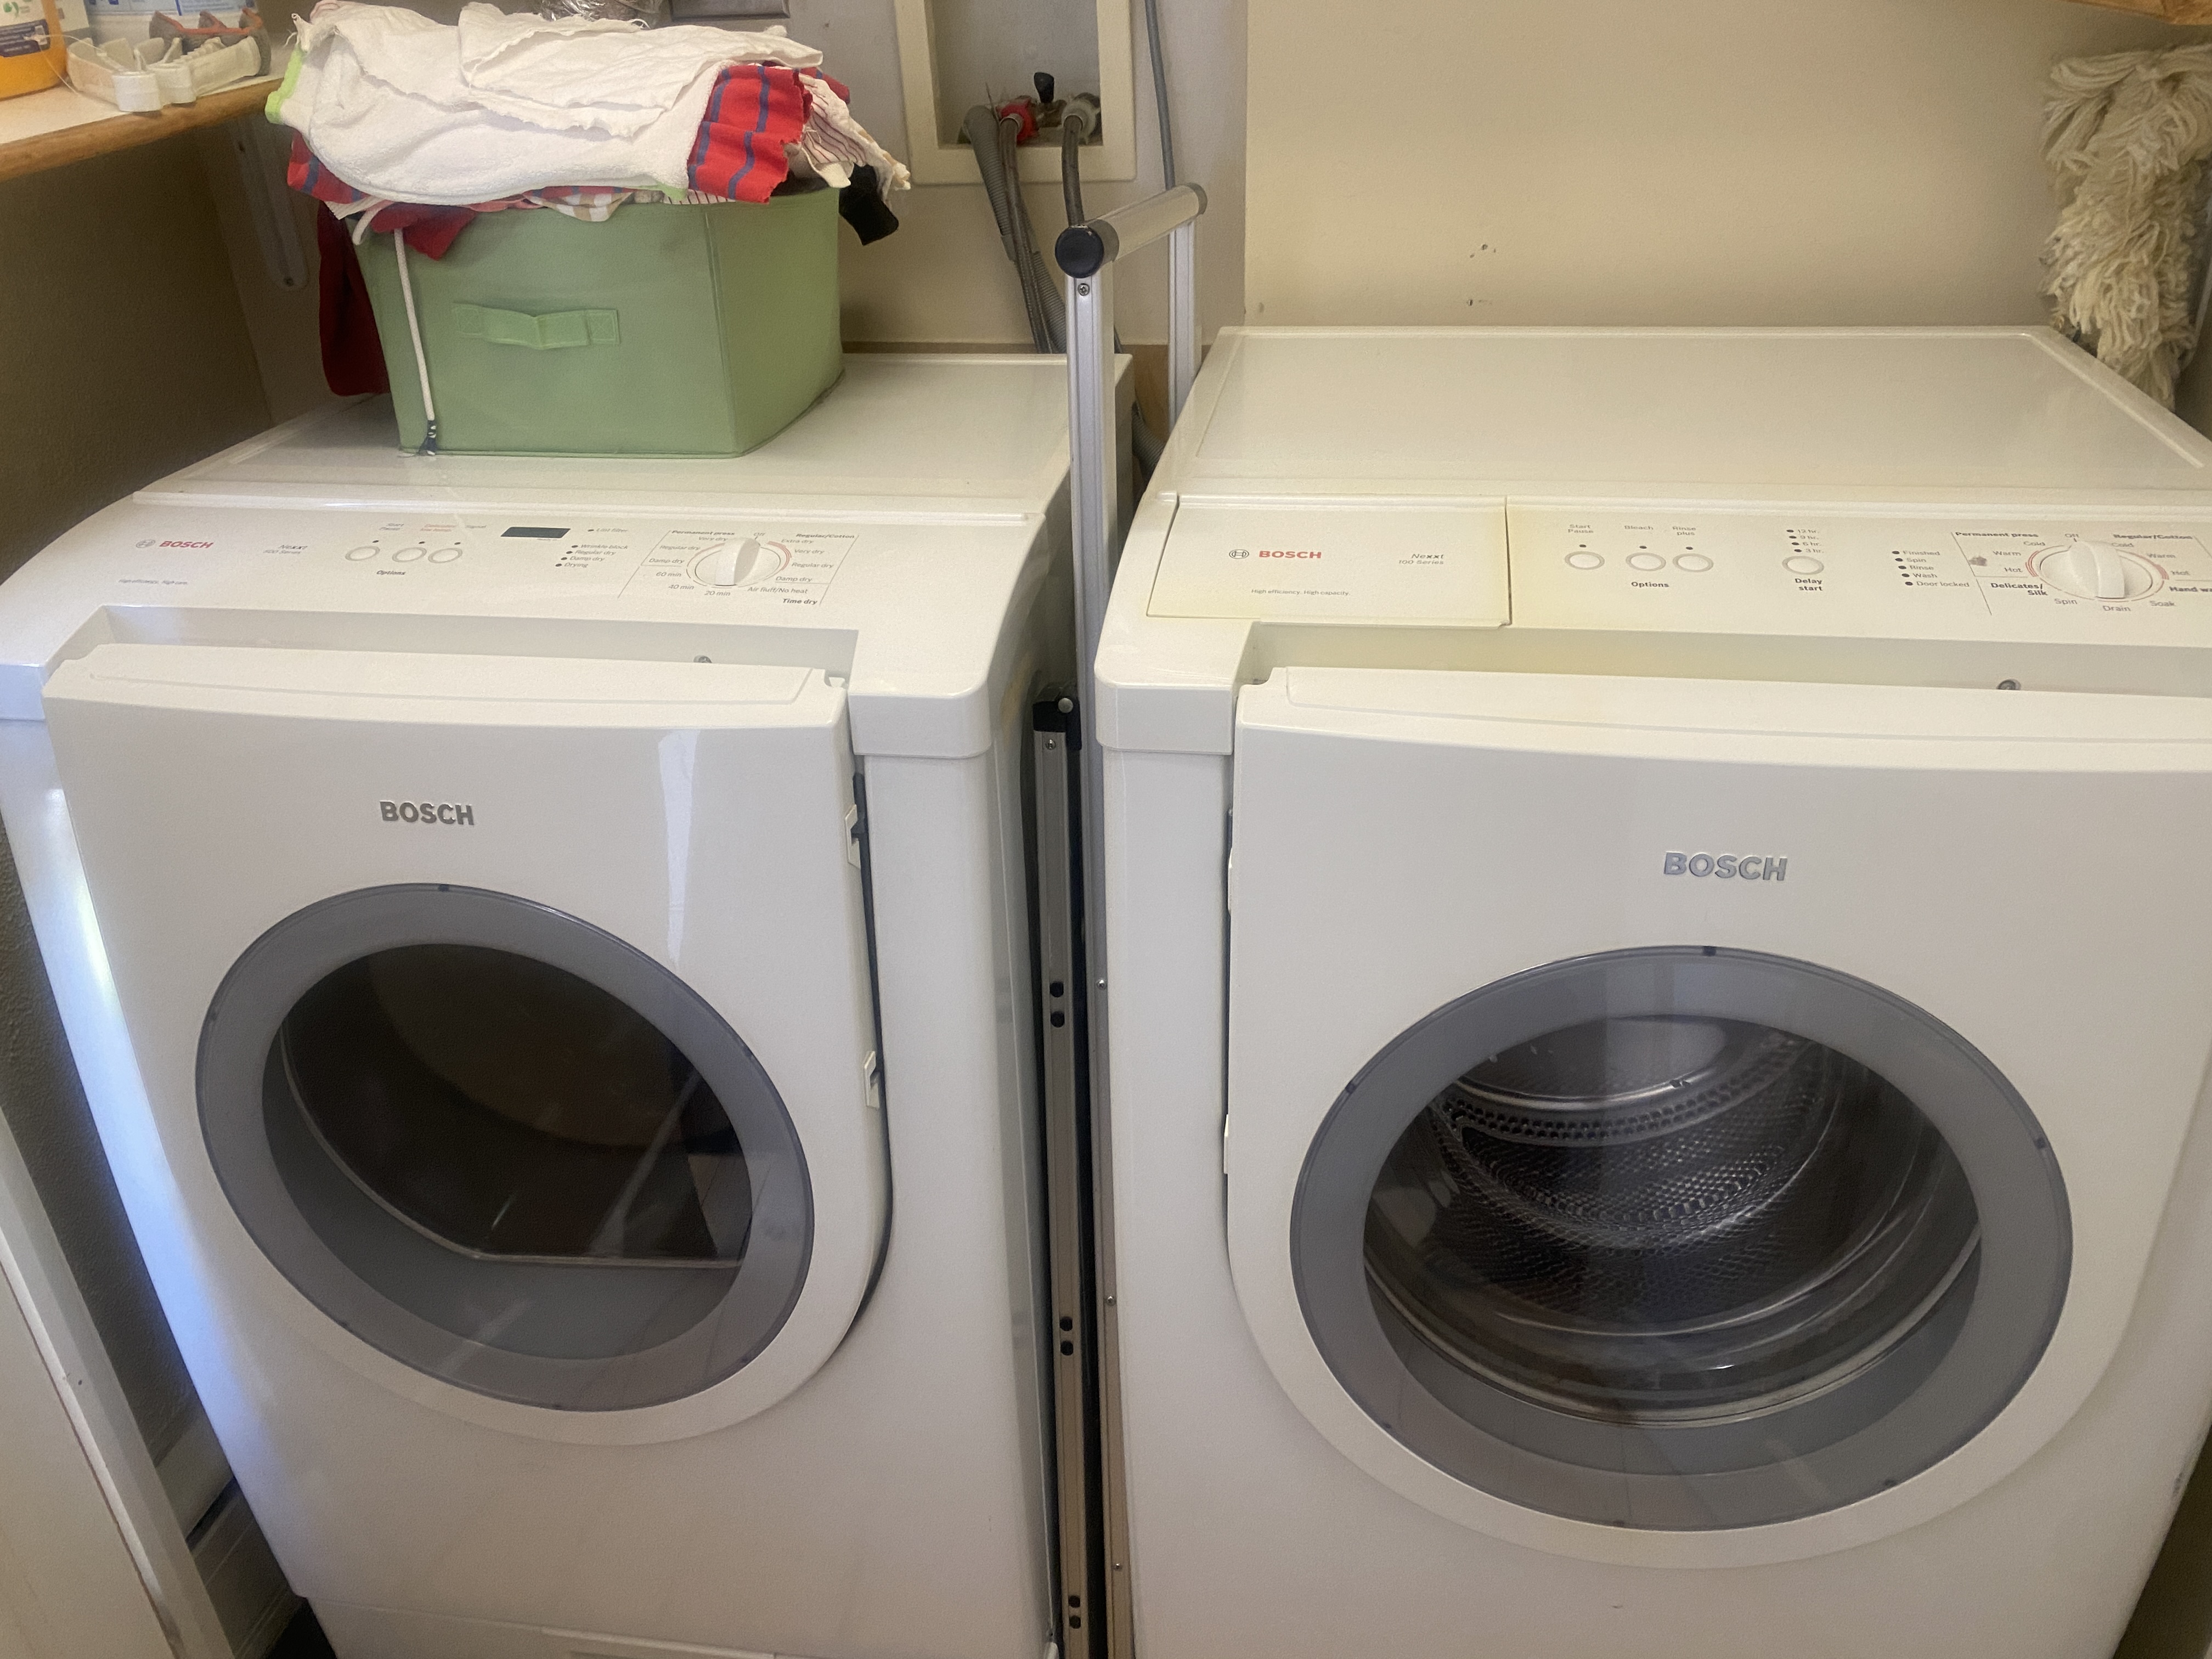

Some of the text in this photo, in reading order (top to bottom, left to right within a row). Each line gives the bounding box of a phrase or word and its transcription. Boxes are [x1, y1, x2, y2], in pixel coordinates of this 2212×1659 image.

[1259, 550, 1322, 559] BOSCH
[380, 799, 475, 826] BOSCH
[1663, 851, 1788, 881] BOSCH
